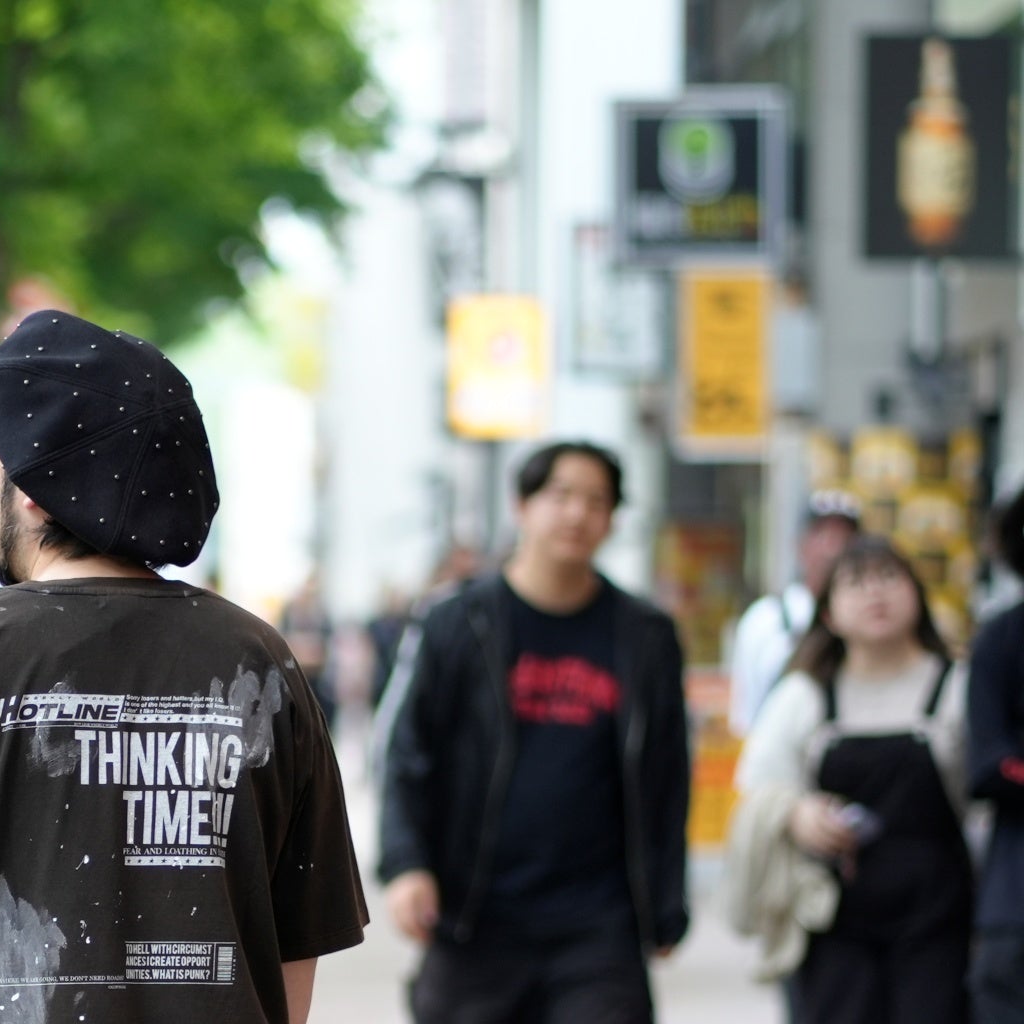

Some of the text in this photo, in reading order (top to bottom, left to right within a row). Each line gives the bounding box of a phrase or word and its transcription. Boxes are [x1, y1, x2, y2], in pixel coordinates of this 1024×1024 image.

[2, 695, 120, 724] HOTLINE
[75, 730, 243, 789] THINKING
[122, 790, 235, 848] TIME!!
[122, 847, 141, 855] FEAR
[181, 956, 212, 967] OPPORT
